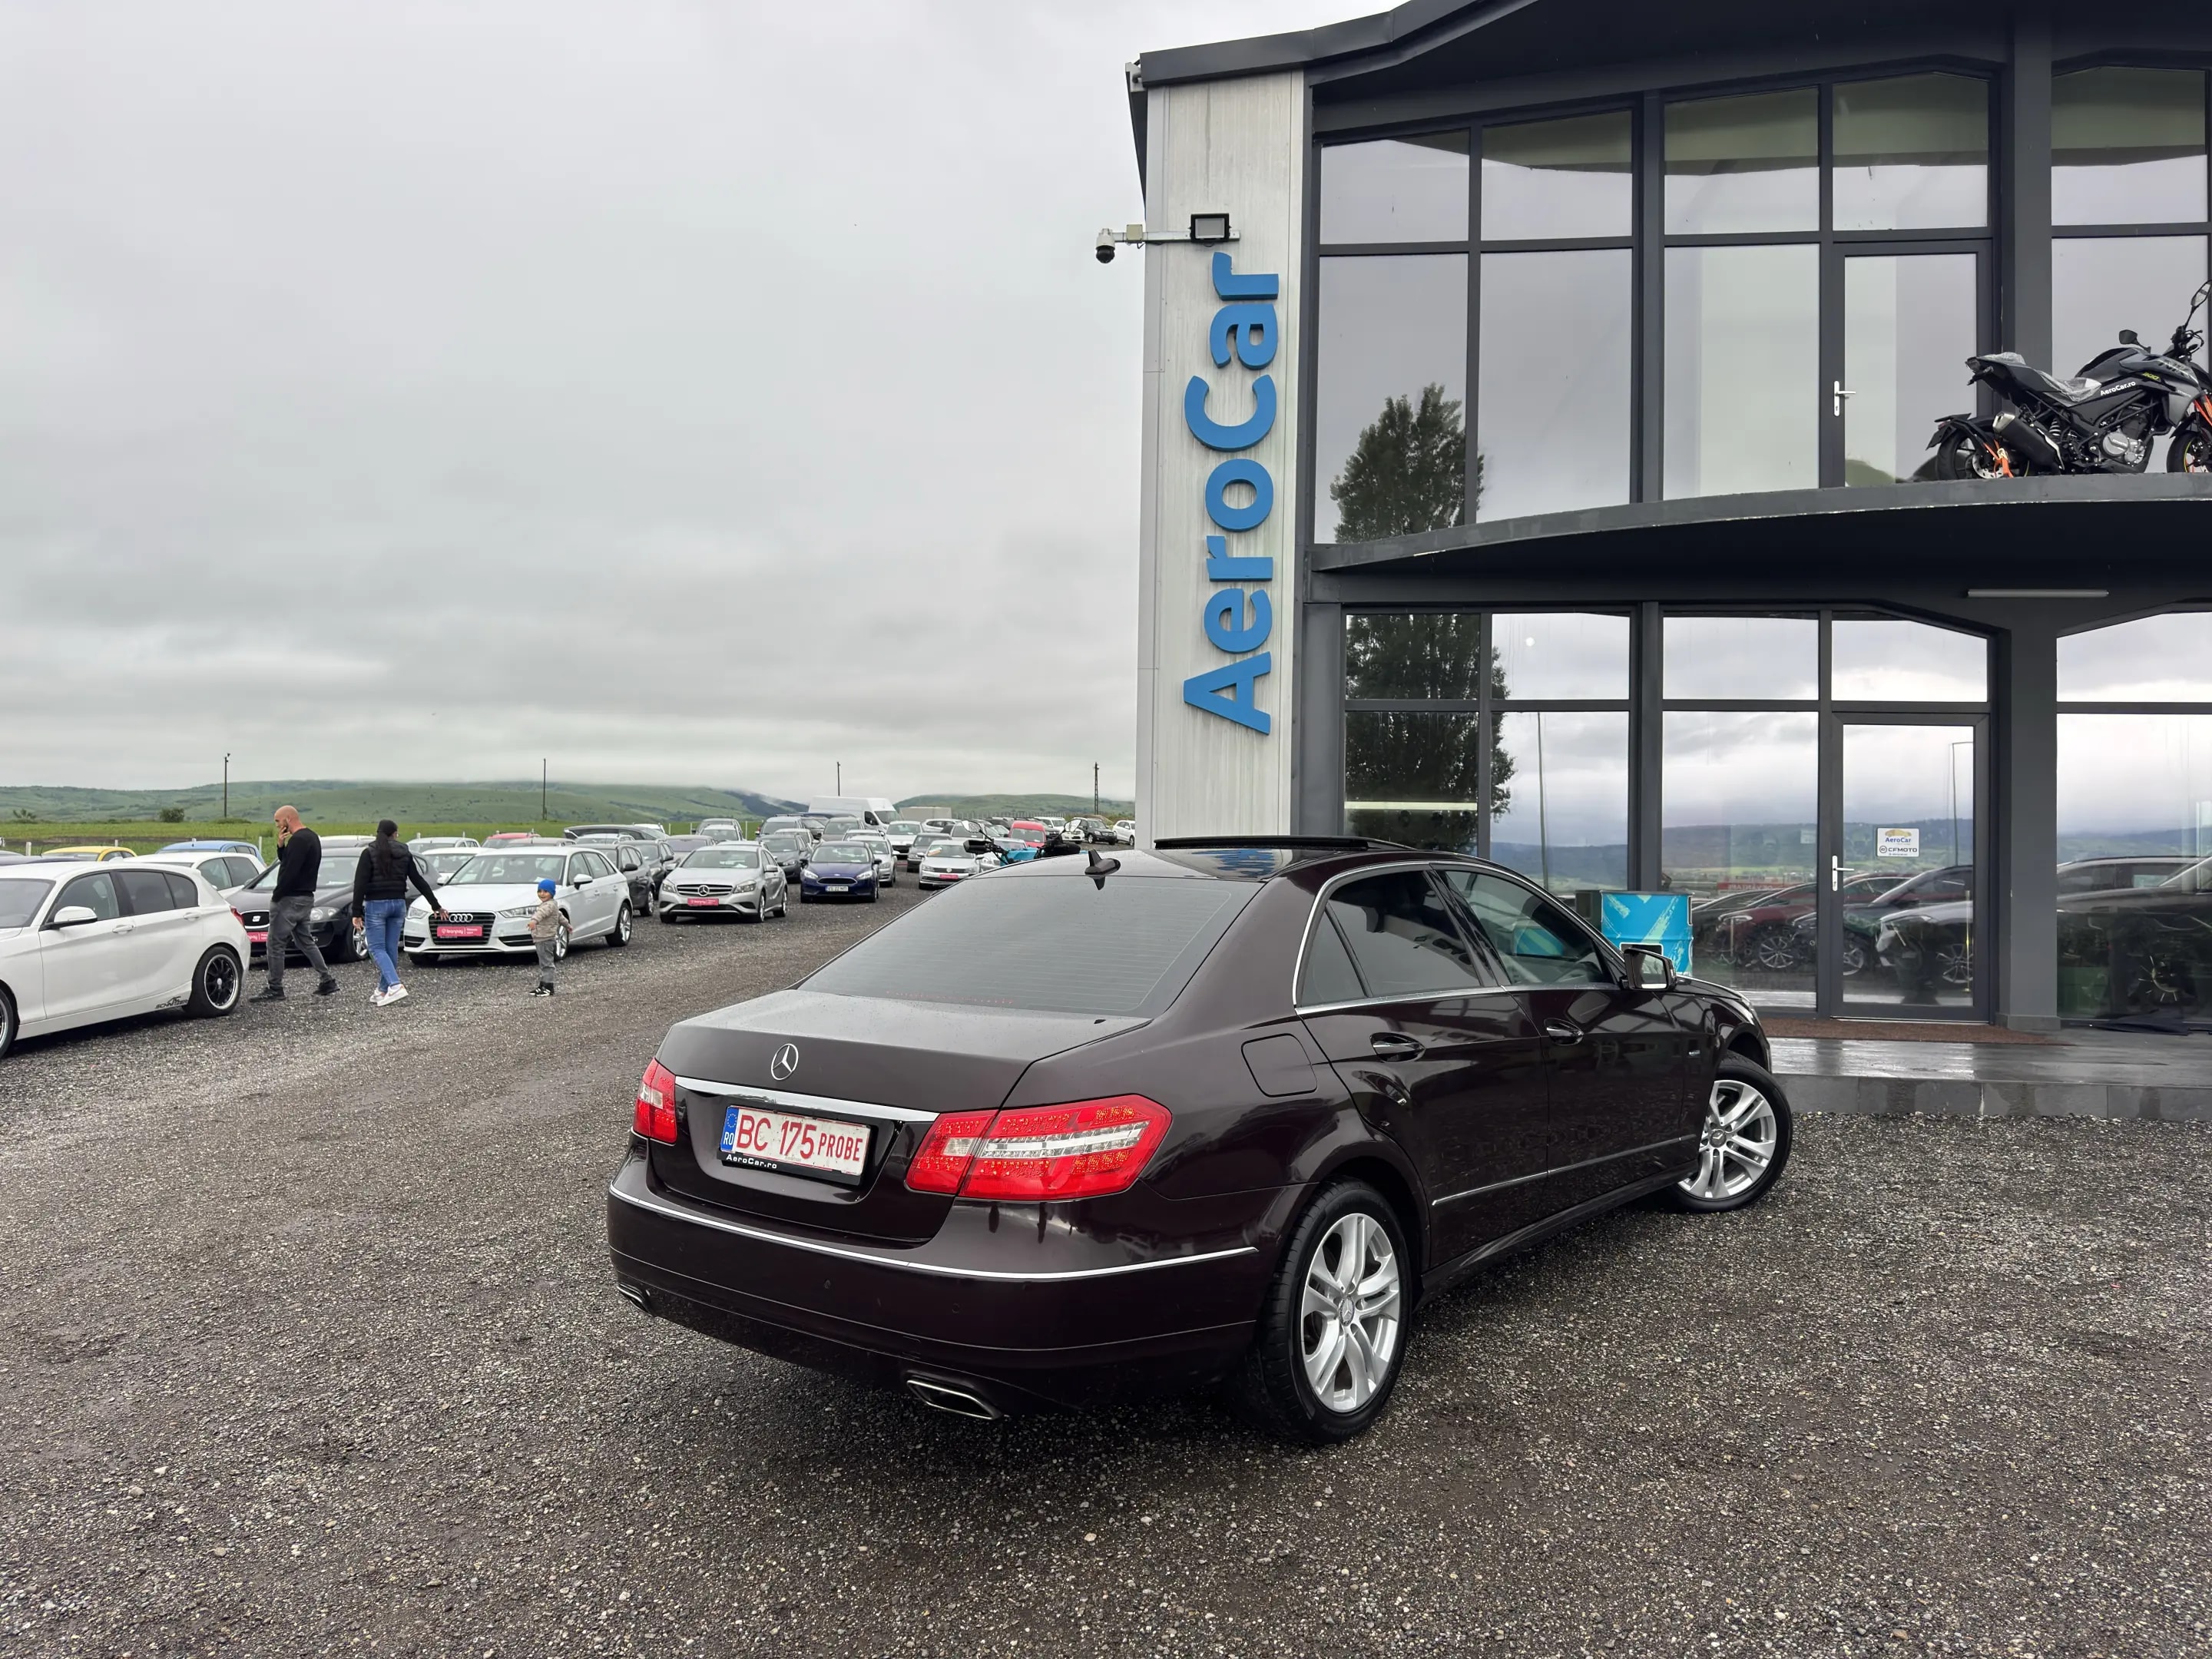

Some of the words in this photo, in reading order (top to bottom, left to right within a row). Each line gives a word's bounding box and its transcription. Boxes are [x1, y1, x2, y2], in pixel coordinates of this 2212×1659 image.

[2100, 381, 2136, 396] AeroCar.ro
[1184, 252, 1279, 735] AeroCar
[723, 1131, 734, 1145] RO
[736, 1114, 771, 1151] BC
[779, 1120, 817, 1160] 175
[817, 1132, 863, 1162] PROBE
[726, 1154, 777, 1169] AeroCar.ro
